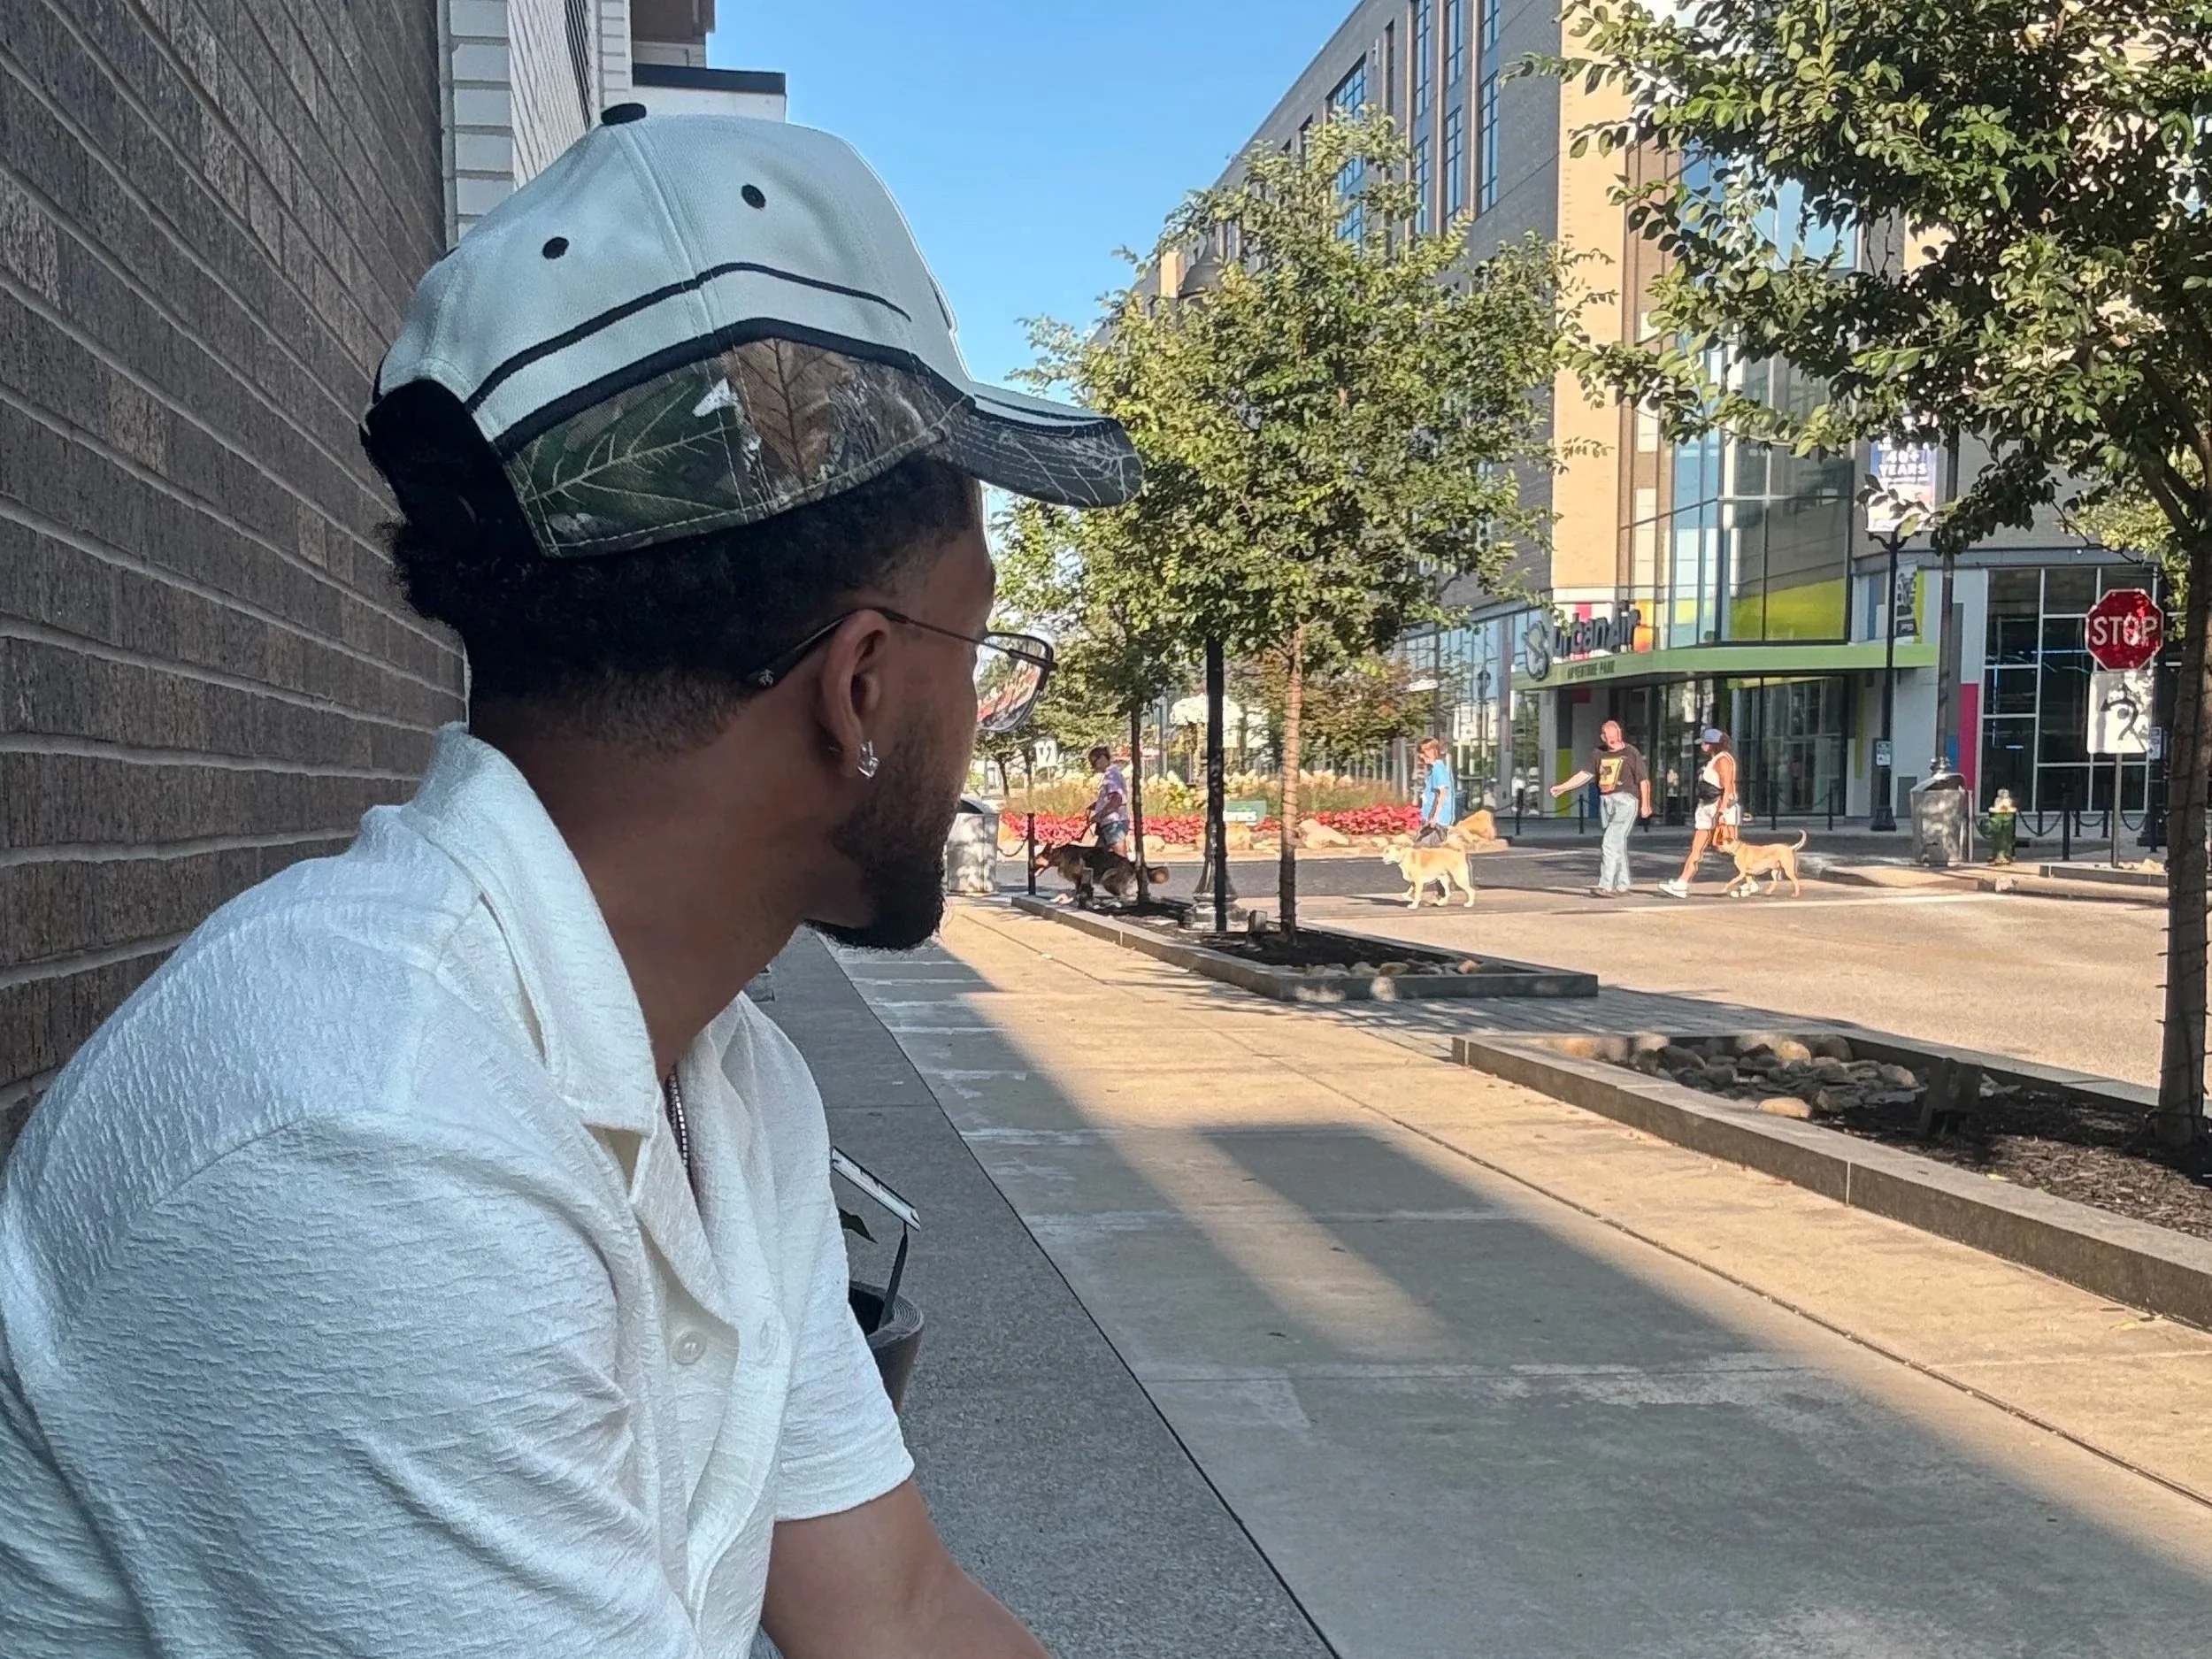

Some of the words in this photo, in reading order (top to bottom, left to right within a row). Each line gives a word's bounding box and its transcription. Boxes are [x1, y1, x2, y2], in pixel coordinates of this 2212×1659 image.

[1886, 450, 1919, 463] 40+
[1878, 463, 1927, 475] YEARS
[2092, 616, 2158, 646] STOP
